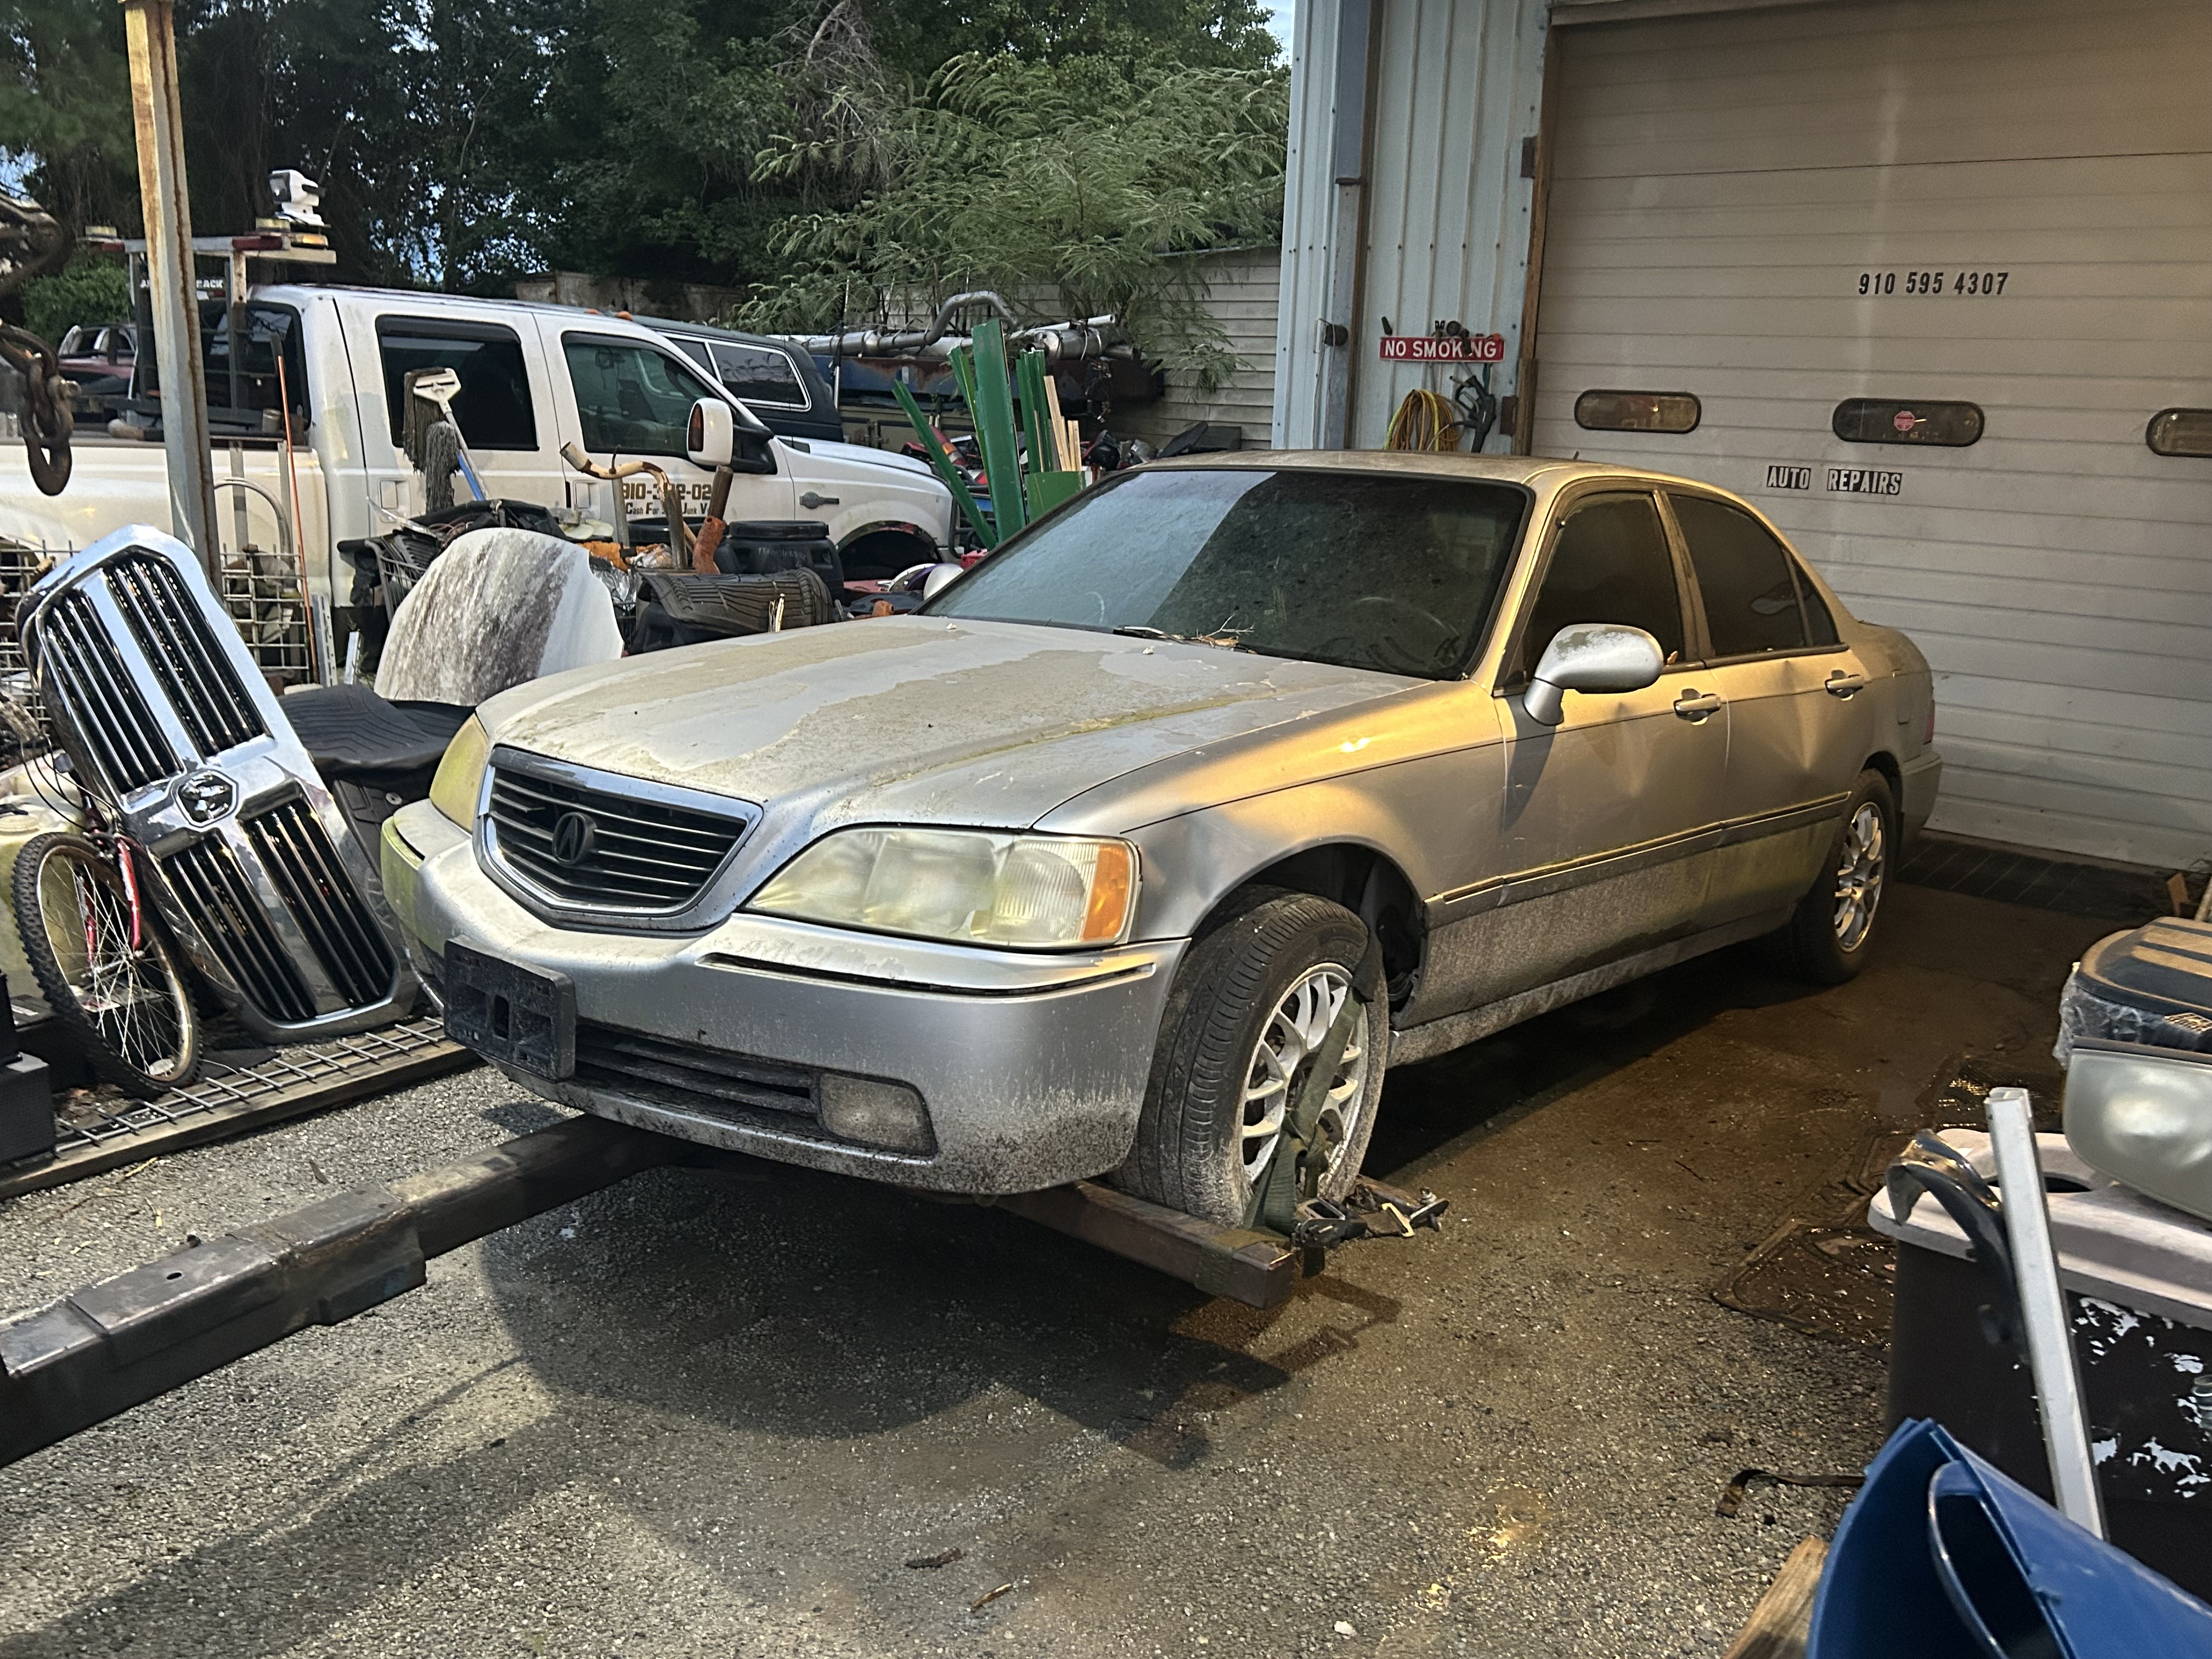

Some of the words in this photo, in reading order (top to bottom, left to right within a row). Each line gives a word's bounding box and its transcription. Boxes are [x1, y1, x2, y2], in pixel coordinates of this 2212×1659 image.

[1859, 273, 1895, 295] 910
[1906, 272, 1944, 294] 595
[1954, 272, 2008, 295] 4307
[1385, 340, 1406, 357] NO
[1413, 340, 1497, 358] SMOKNG
[1767, 466, 1811, 489] AUTO
[1827, 469, 1901, 494] REPAIRS
[626, 502, 644, 515] Cash
[646, 502, 659, 515] For
[682, 503, 697, 515] Junk
